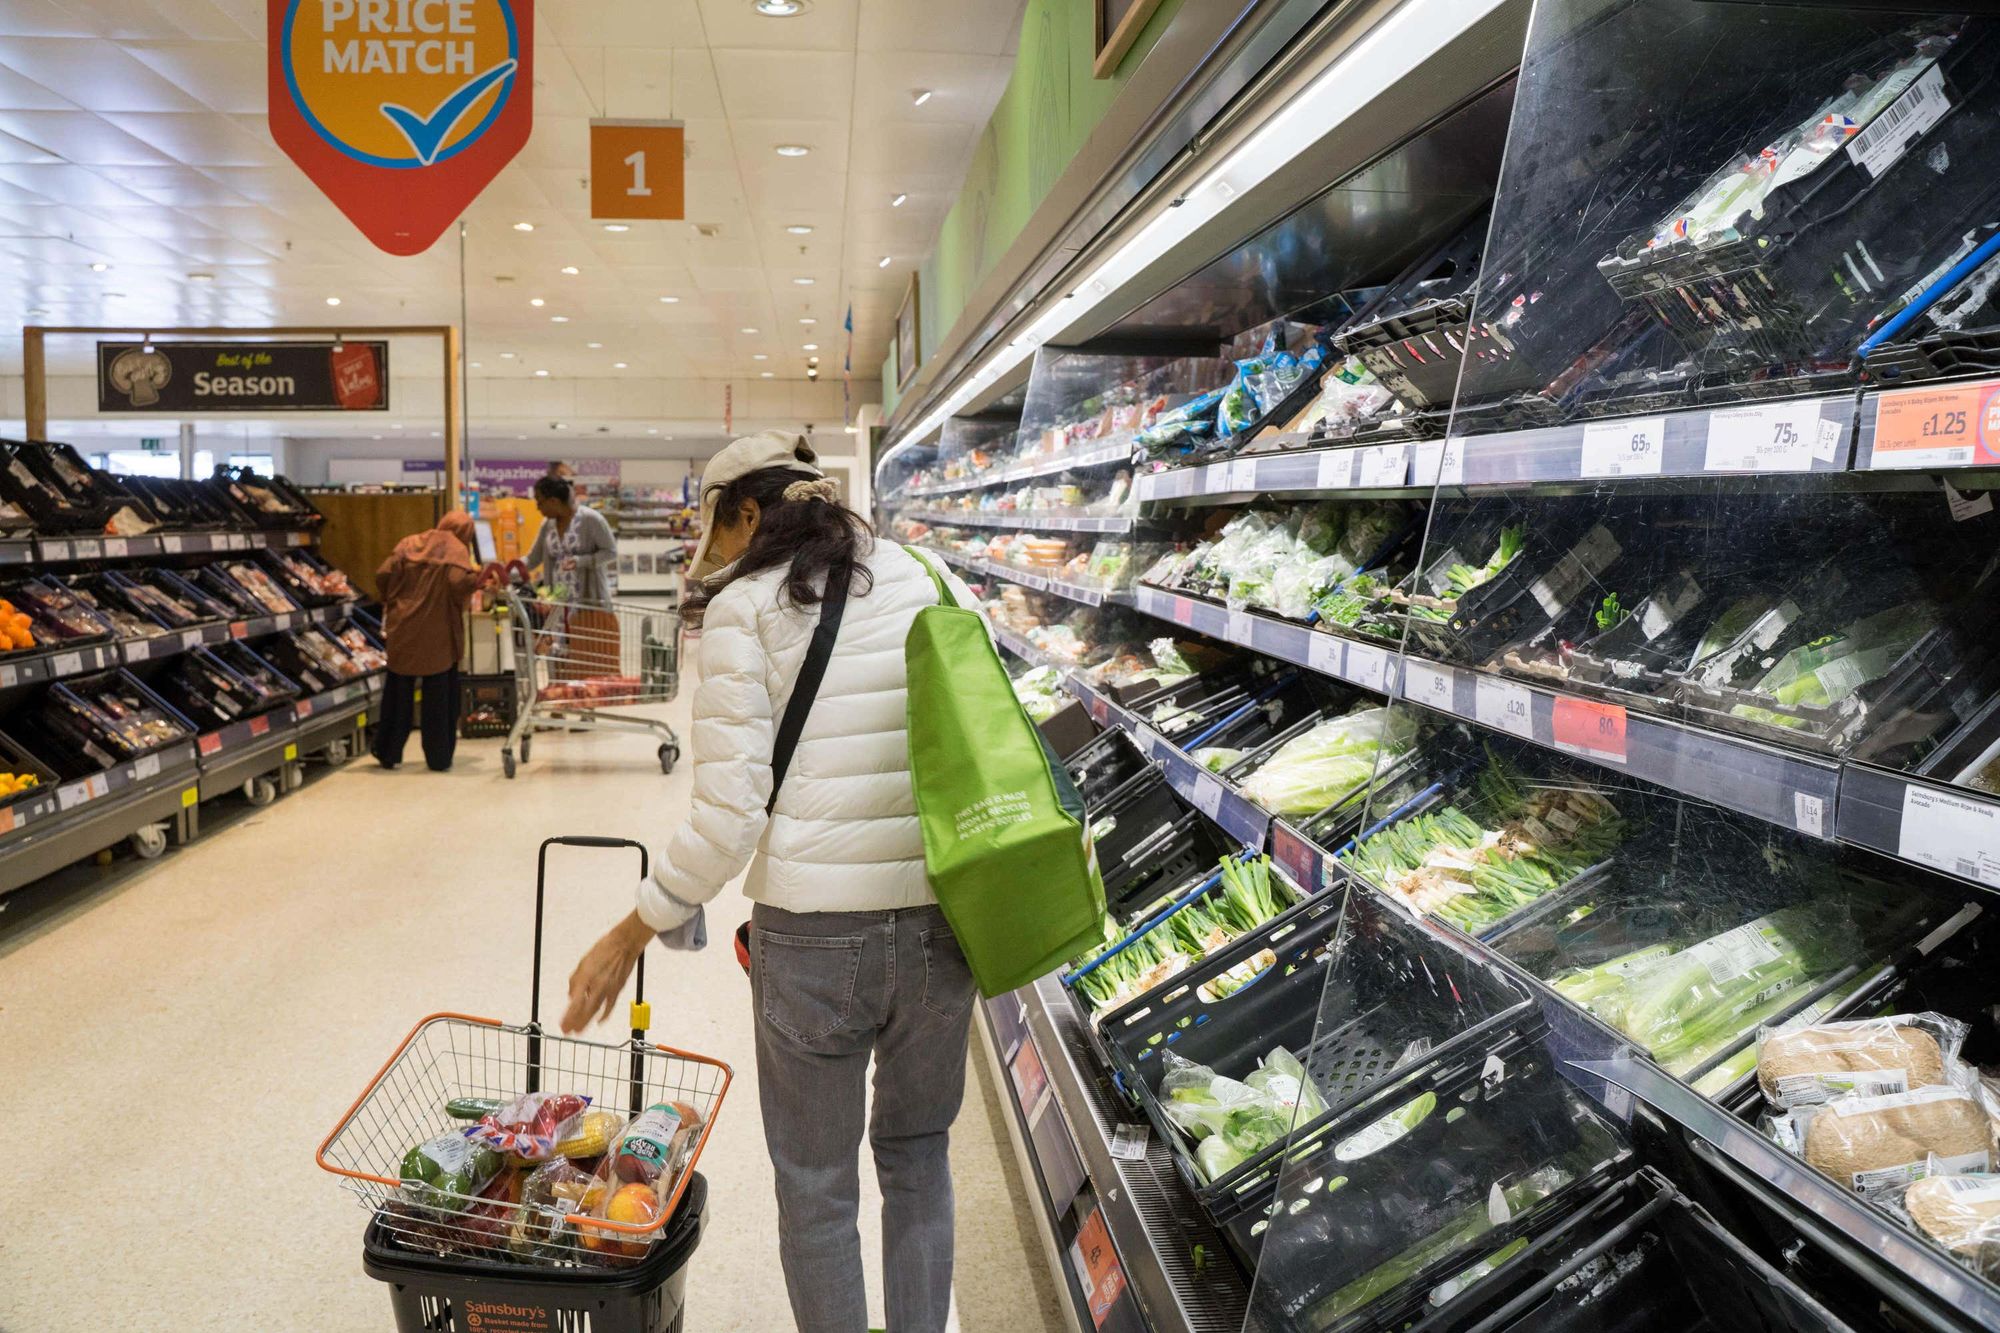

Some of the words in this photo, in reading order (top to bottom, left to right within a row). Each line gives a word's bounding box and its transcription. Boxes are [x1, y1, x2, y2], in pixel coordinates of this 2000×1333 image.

[322, 0, 476, 34] PRICE
[323, 39, 475, 75] MATCH
[624, 150, 652, 196] 1
[216, 352, 240, 367] Best
[240, 353, 253, 370] of
[255, 352, 272, 365] the
[193, 371, 296, 396] Season
[1922, 411, 1967, 436] £1.25
[1631, 433, 1651, 453] 65p
[1773, 422, 1798, 447] 75p
[473, 465, 548, 483] Magazines
[1506, 699, 1525, 717] £1.20
[1910, 798, 1931, 809] Avocado
[1911, 790, 1939, 803] Sainsbury's
[1939, 796, 1960, 808] Medium
[1806, 804, 1818, 817] L14
[465, 1300, 546, 1320] Sainsbury's
[483, 1317, 509, 1326] Basket
[510, 1320, 530, 1328] made
[531, 1321, 548, 1329] from
